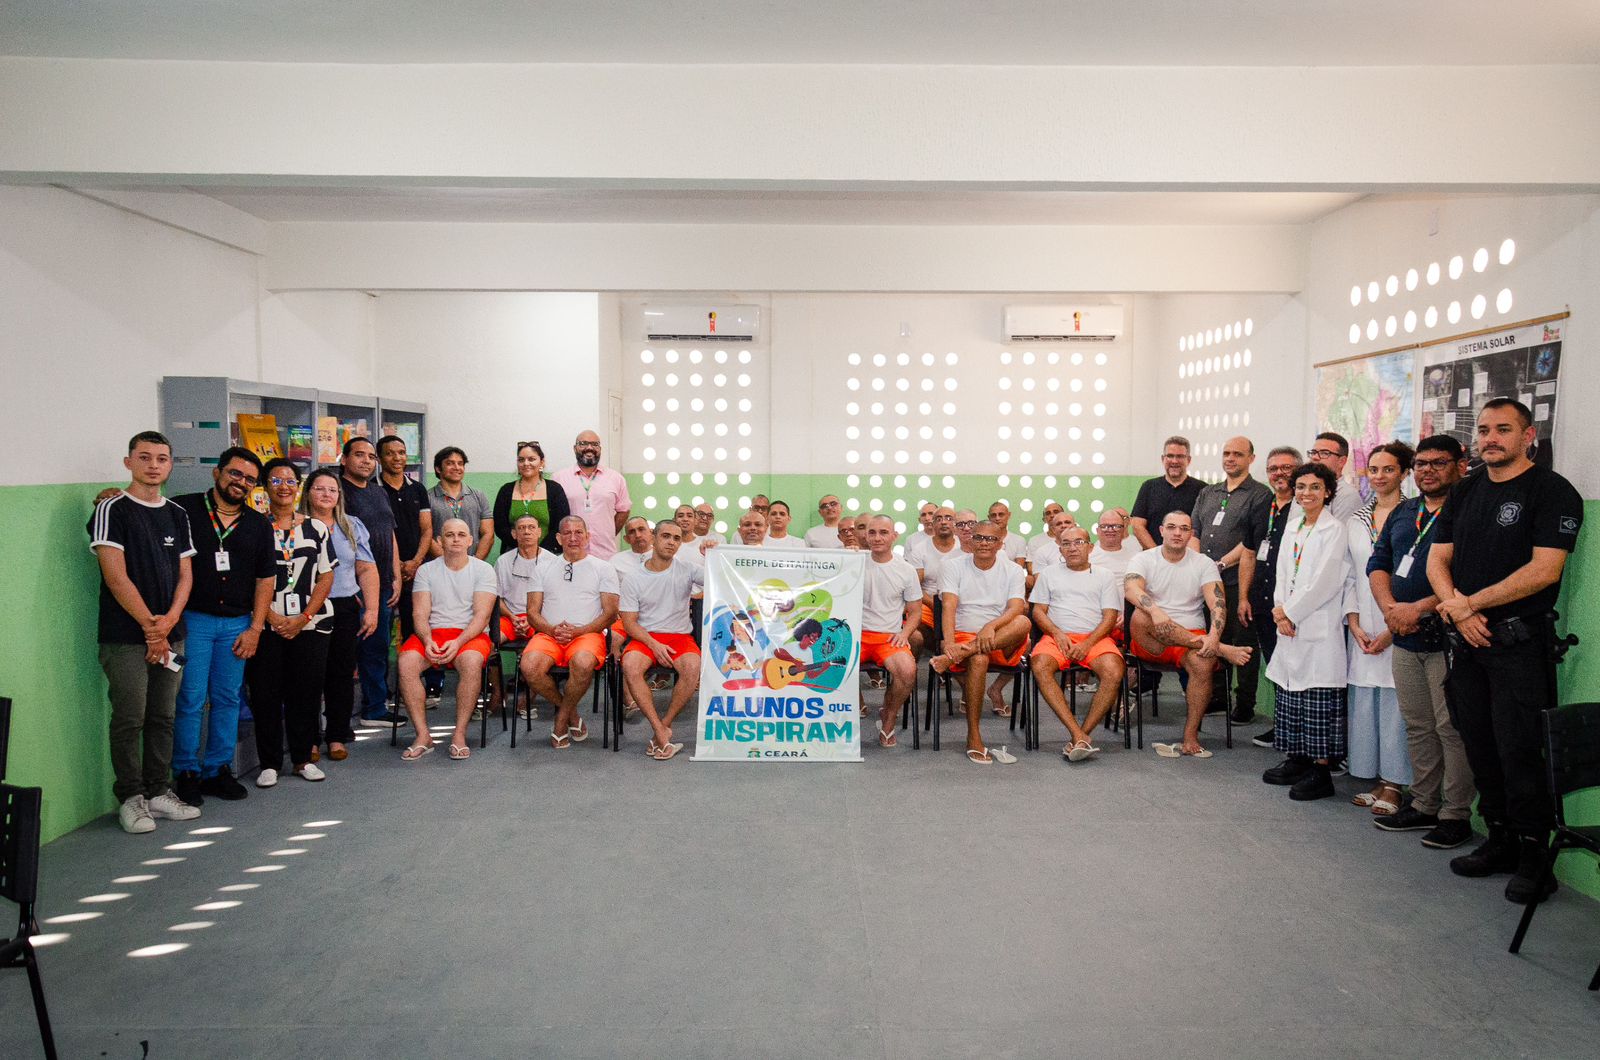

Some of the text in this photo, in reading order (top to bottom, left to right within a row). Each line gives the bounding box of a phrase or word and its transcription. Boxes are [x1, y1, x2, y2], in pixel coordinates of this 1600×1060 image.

[1458, 335, 1515, 354] SISTEMA SOLAR
[735, 558, 768, 568] EEEPPL
[706, 696, 852, 719] ALUNOS QUE
[704, 719, 853, 743] INSPIRAM
[764, 749, 808, 758] CEARÁ
